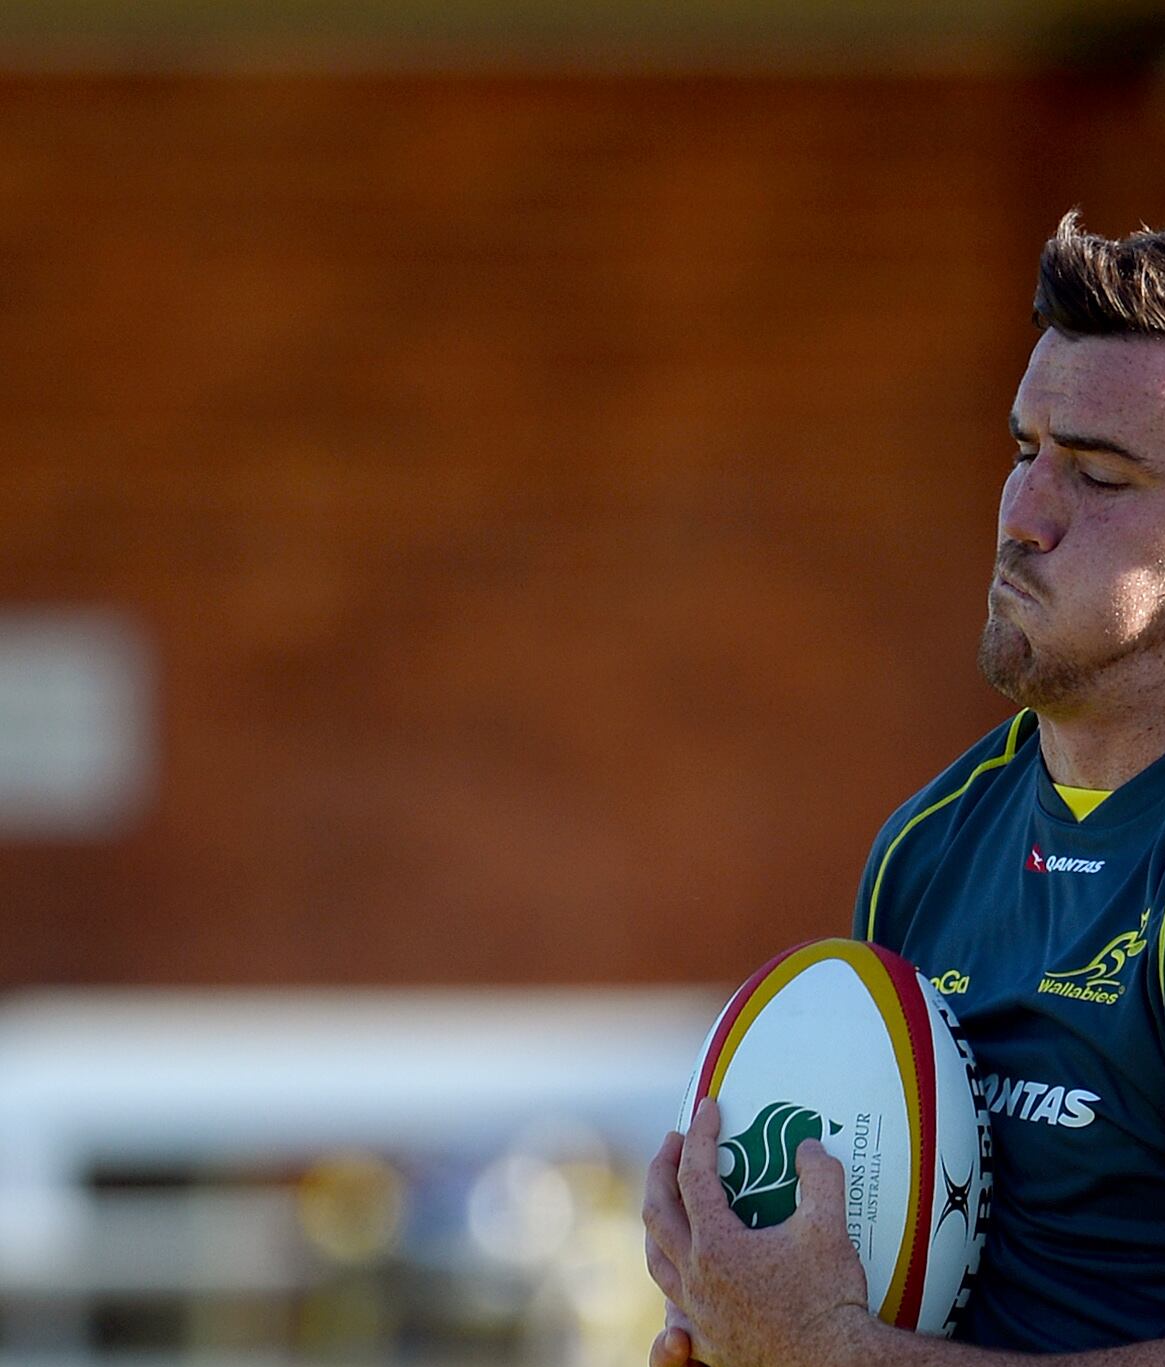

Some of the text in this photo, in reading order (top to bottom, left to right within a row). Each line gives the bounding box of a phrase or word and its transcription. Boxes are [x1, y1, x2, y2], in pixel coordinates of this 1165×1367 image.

[1045, 855, 1106, 874] QANTAS
[929, 969, 971, 995] oGa
[1037, 979, 1119, 1005] Wallabies
[982, 1073, 1102, 1129] ANTAS
[847, 1112, 871, 1259] 013 LIONS TOUR
[867, 1153, 882, 1223] AUSTRALIA
